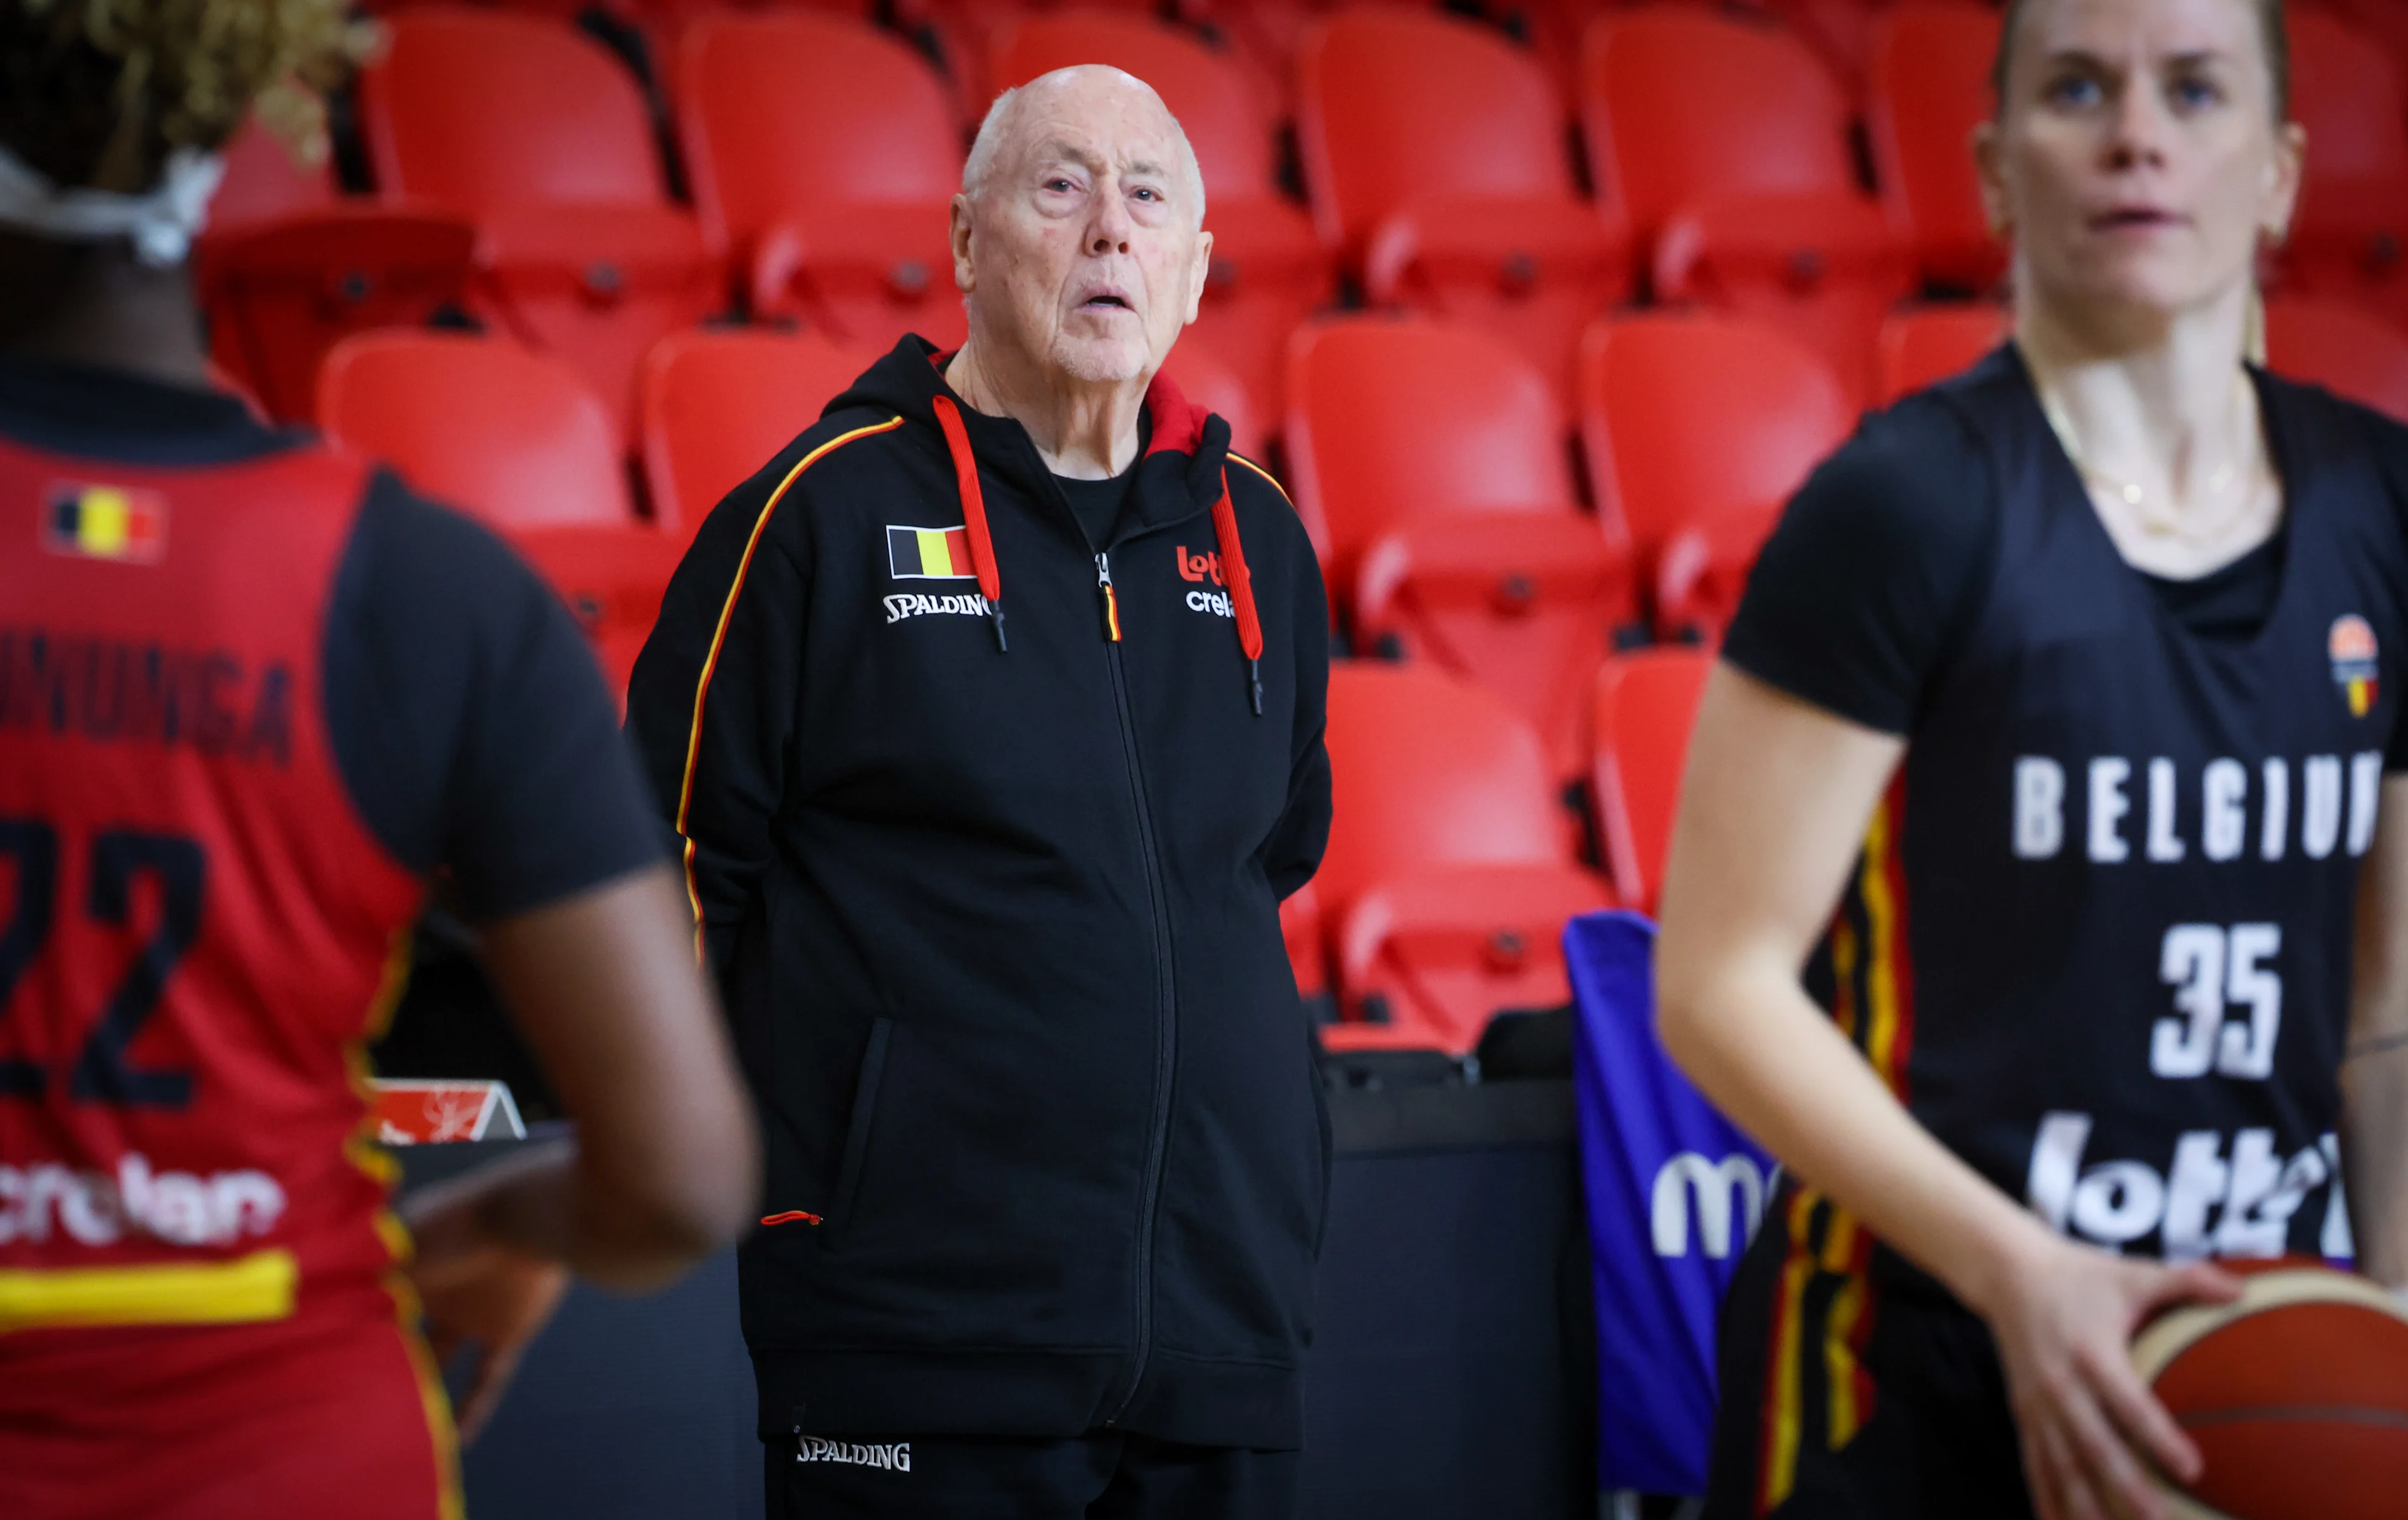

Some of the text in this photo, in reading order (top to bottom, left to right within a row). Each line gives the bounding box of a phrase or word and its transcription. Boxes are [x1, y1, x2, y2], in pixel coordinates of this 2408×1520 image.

[1186, 591, 1237, 618] crel
[2149, 922, 2283, 1081] 35
[796, 1435, 910, 1472] SPALDING
